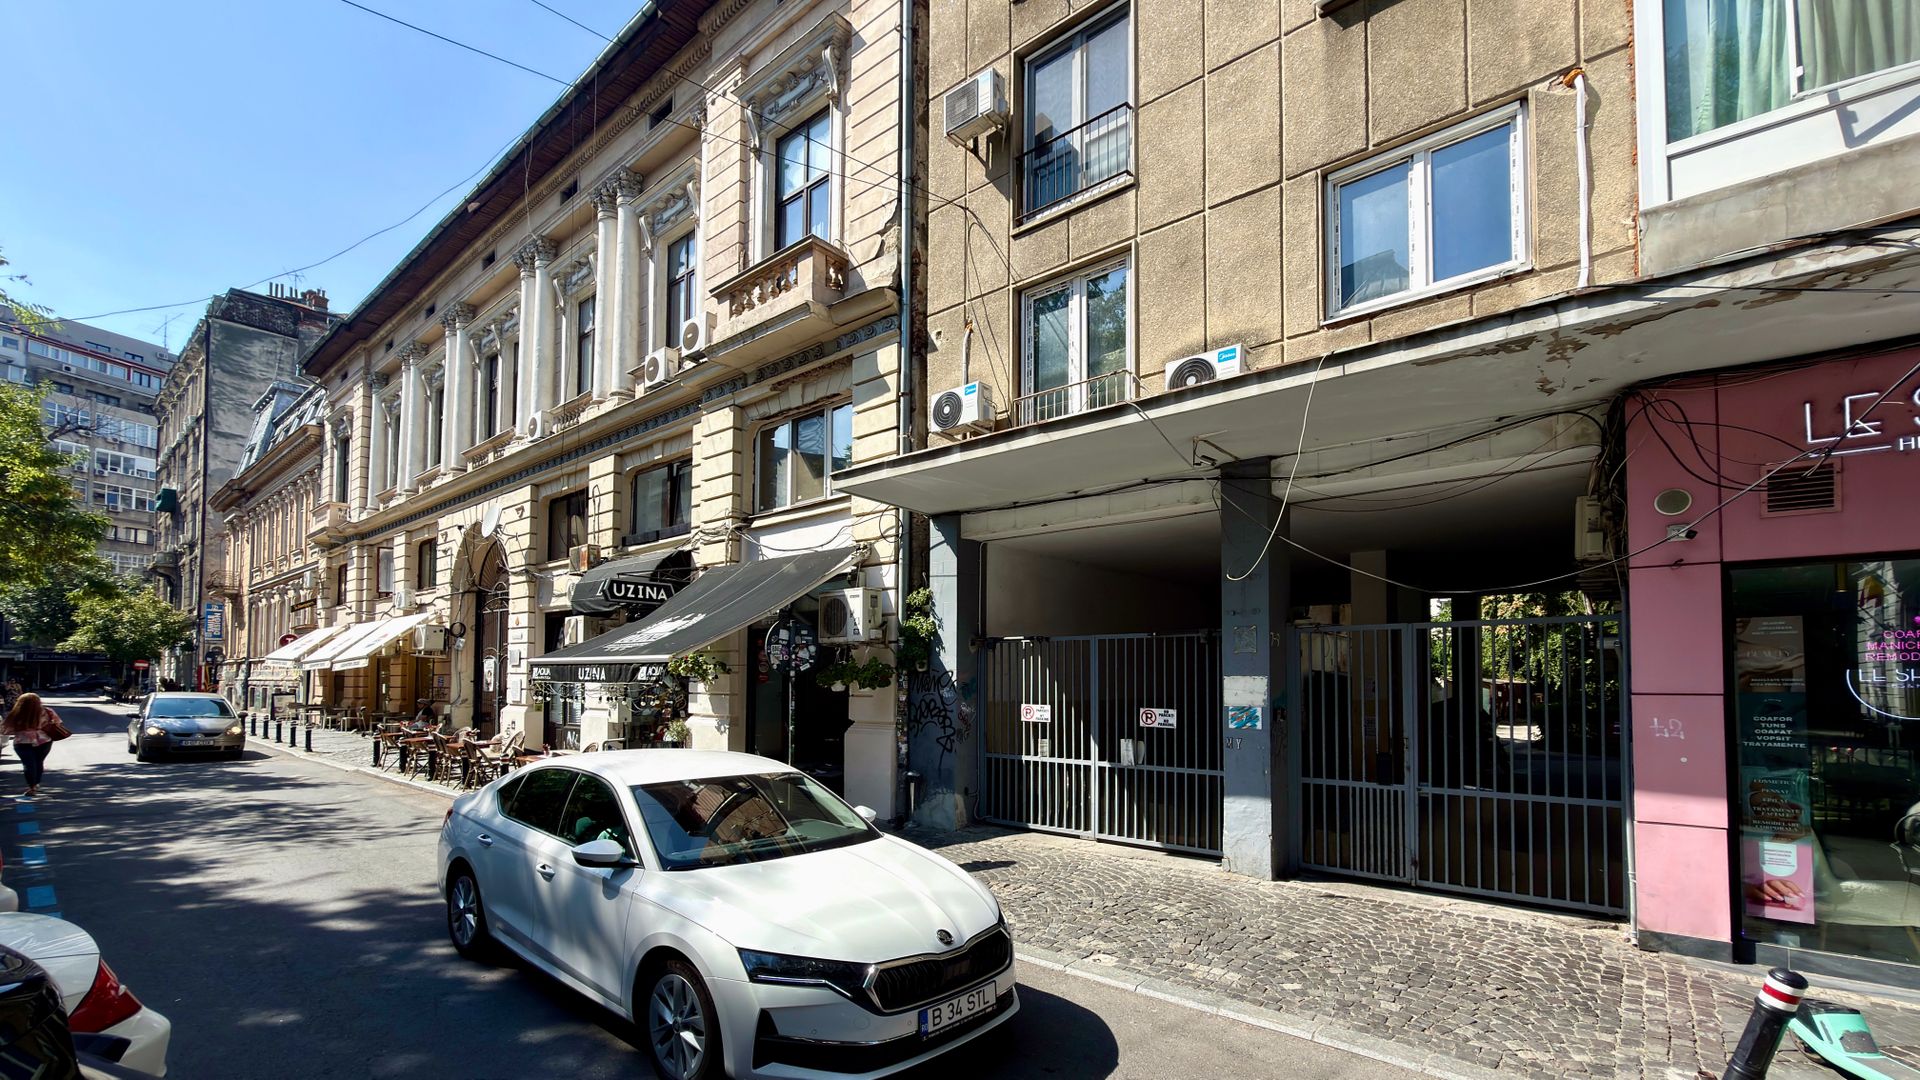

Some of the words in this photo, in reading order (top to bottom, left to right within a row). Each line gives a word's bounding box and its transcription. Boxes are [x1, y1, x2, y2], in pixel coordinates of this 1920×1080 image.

[1805, 392, 1881, 444] LE
[613, 583, 668, 600] UZINA
[578, 667, 606, 680] UZINA
[1859, 669, 1886, 682] LE
[932, 1007, 942, 1027] B
[947, 999, 962, 1020] 34
[967, 989, 990, 1012] STL
